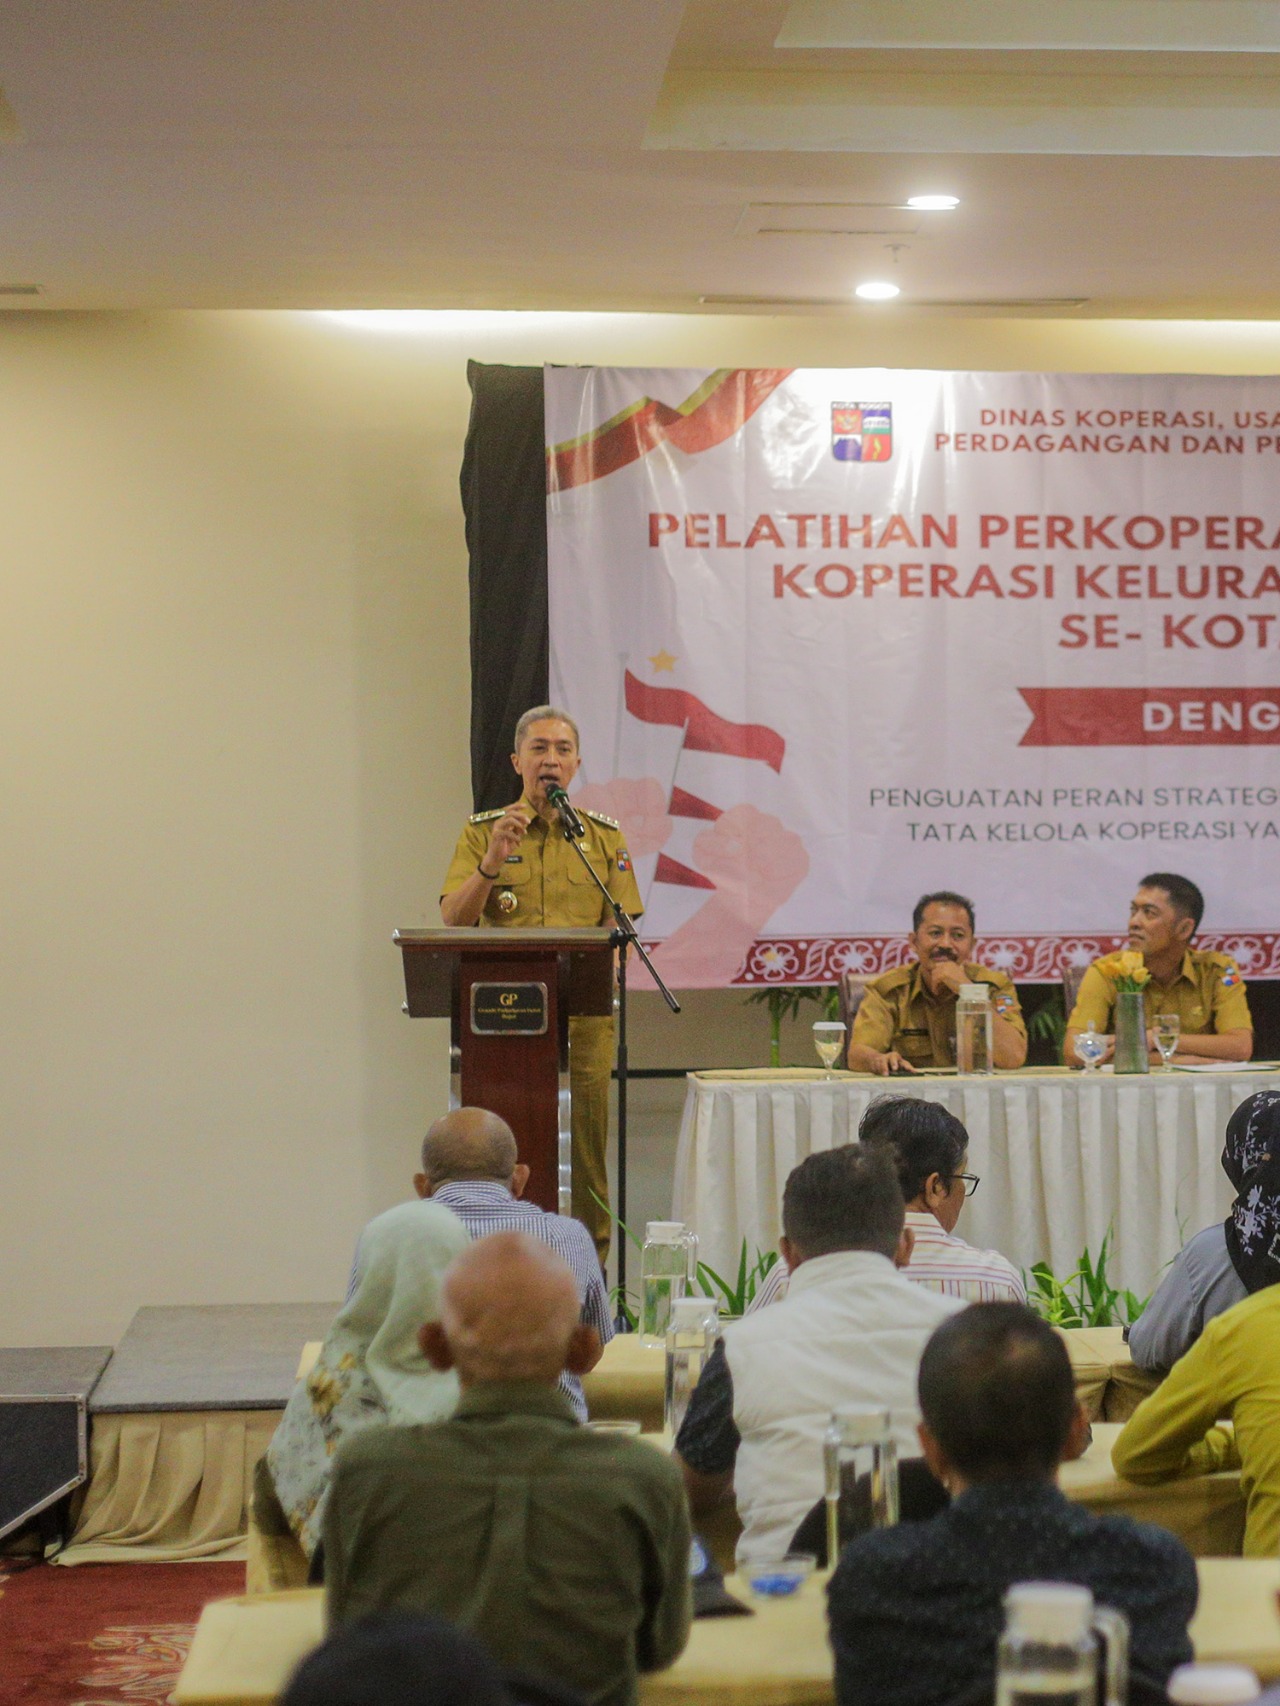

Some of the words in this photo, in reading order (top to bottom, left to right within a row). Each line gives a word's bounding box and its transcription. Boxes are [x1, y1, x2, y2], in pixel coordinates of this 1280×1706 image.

[980, 409, 1066, 427] DINAS
[1076, 410, 1225, 430] KOPERASI,
[935, 433, 1171, 454] PERDAGANGAN
[1181, 435, 1245, 455] DAN
[649, 513, 958, 549] PELATIHAN
[773, 564, 1054, 599] KOPERASI
[1059, 614, 1141, 649] SE-
[870, 789, 1042, 807] PENGUATAN
[1053, 789, 1143, 807] PERAN
[906, 823, 977, 841] TATA
[987, 823, 1088, 841] KELOLA
[1099, 821, 1236, 841] KOPERASI
[500, 993, 518, 1006] GP
